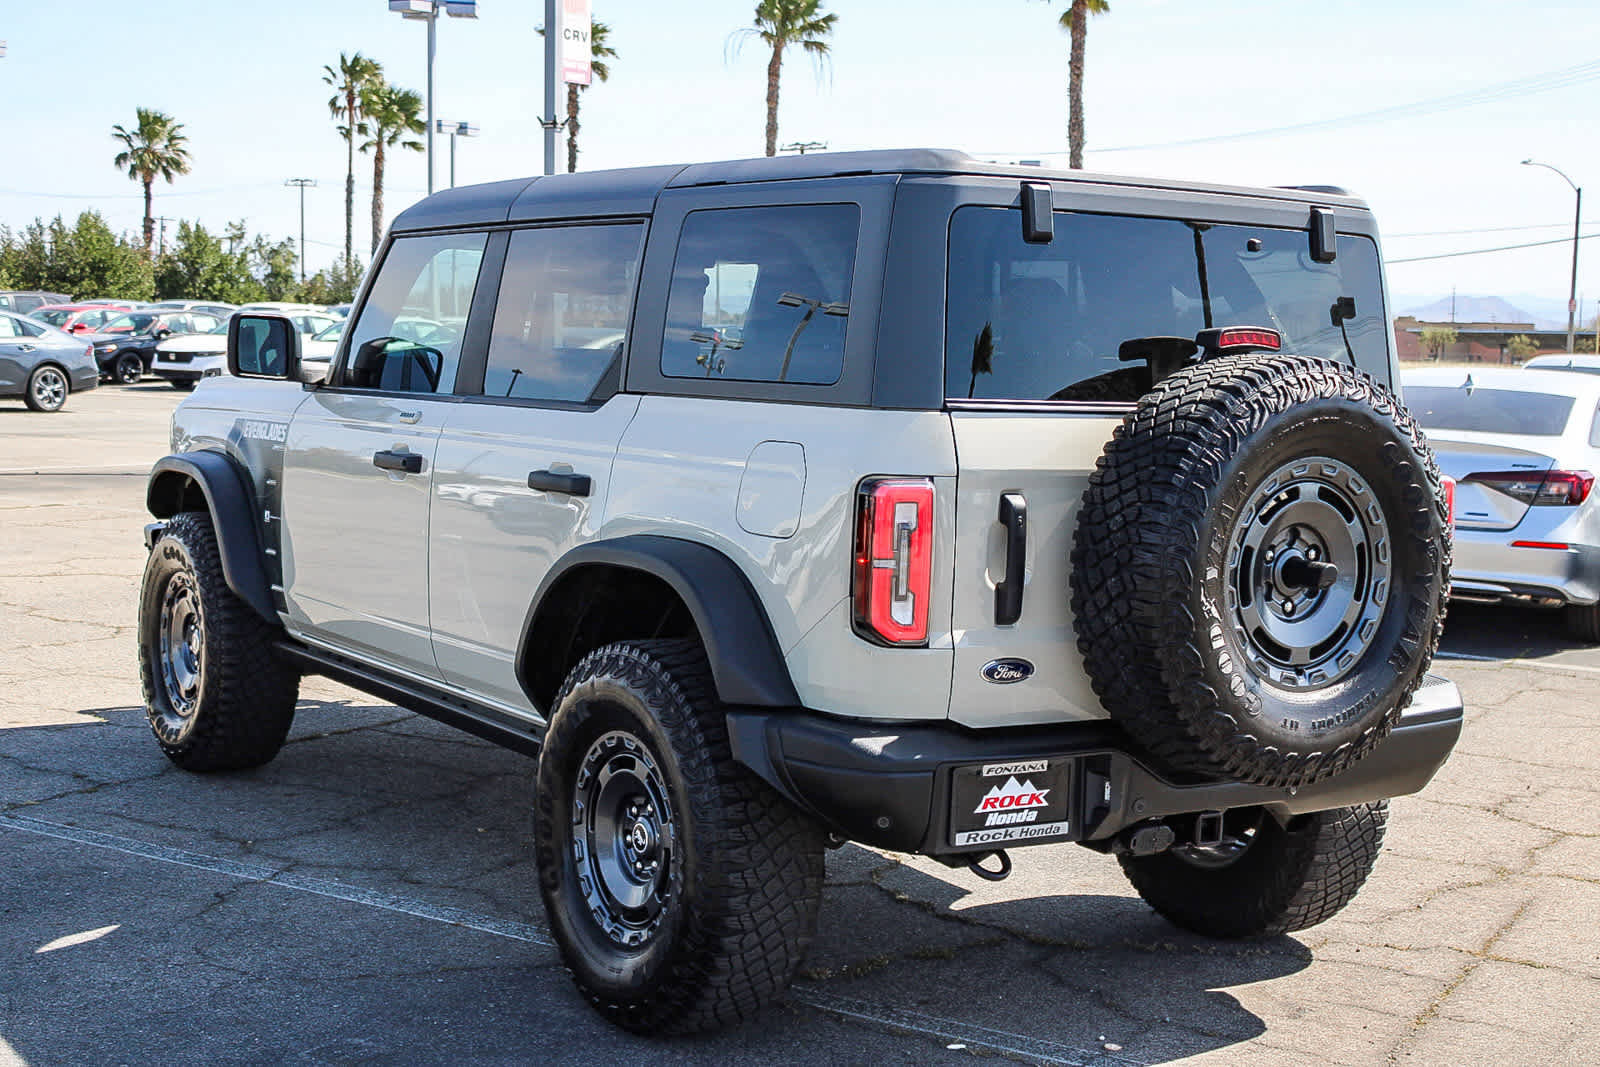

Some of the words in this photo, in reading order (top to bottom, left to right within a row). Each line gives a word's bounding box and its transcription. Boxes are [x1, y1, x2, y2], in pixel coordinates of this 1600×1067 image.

[563, 28, 588, 42] CRV
[986, 762, 1045, 775] FONTANA
[982, 792, 1045, 810] ROCK
[985, 809, 1038, 826] Honda
[966, 830, 1015, 843] Rock
[1019, 824, 1061, 838] Honda
